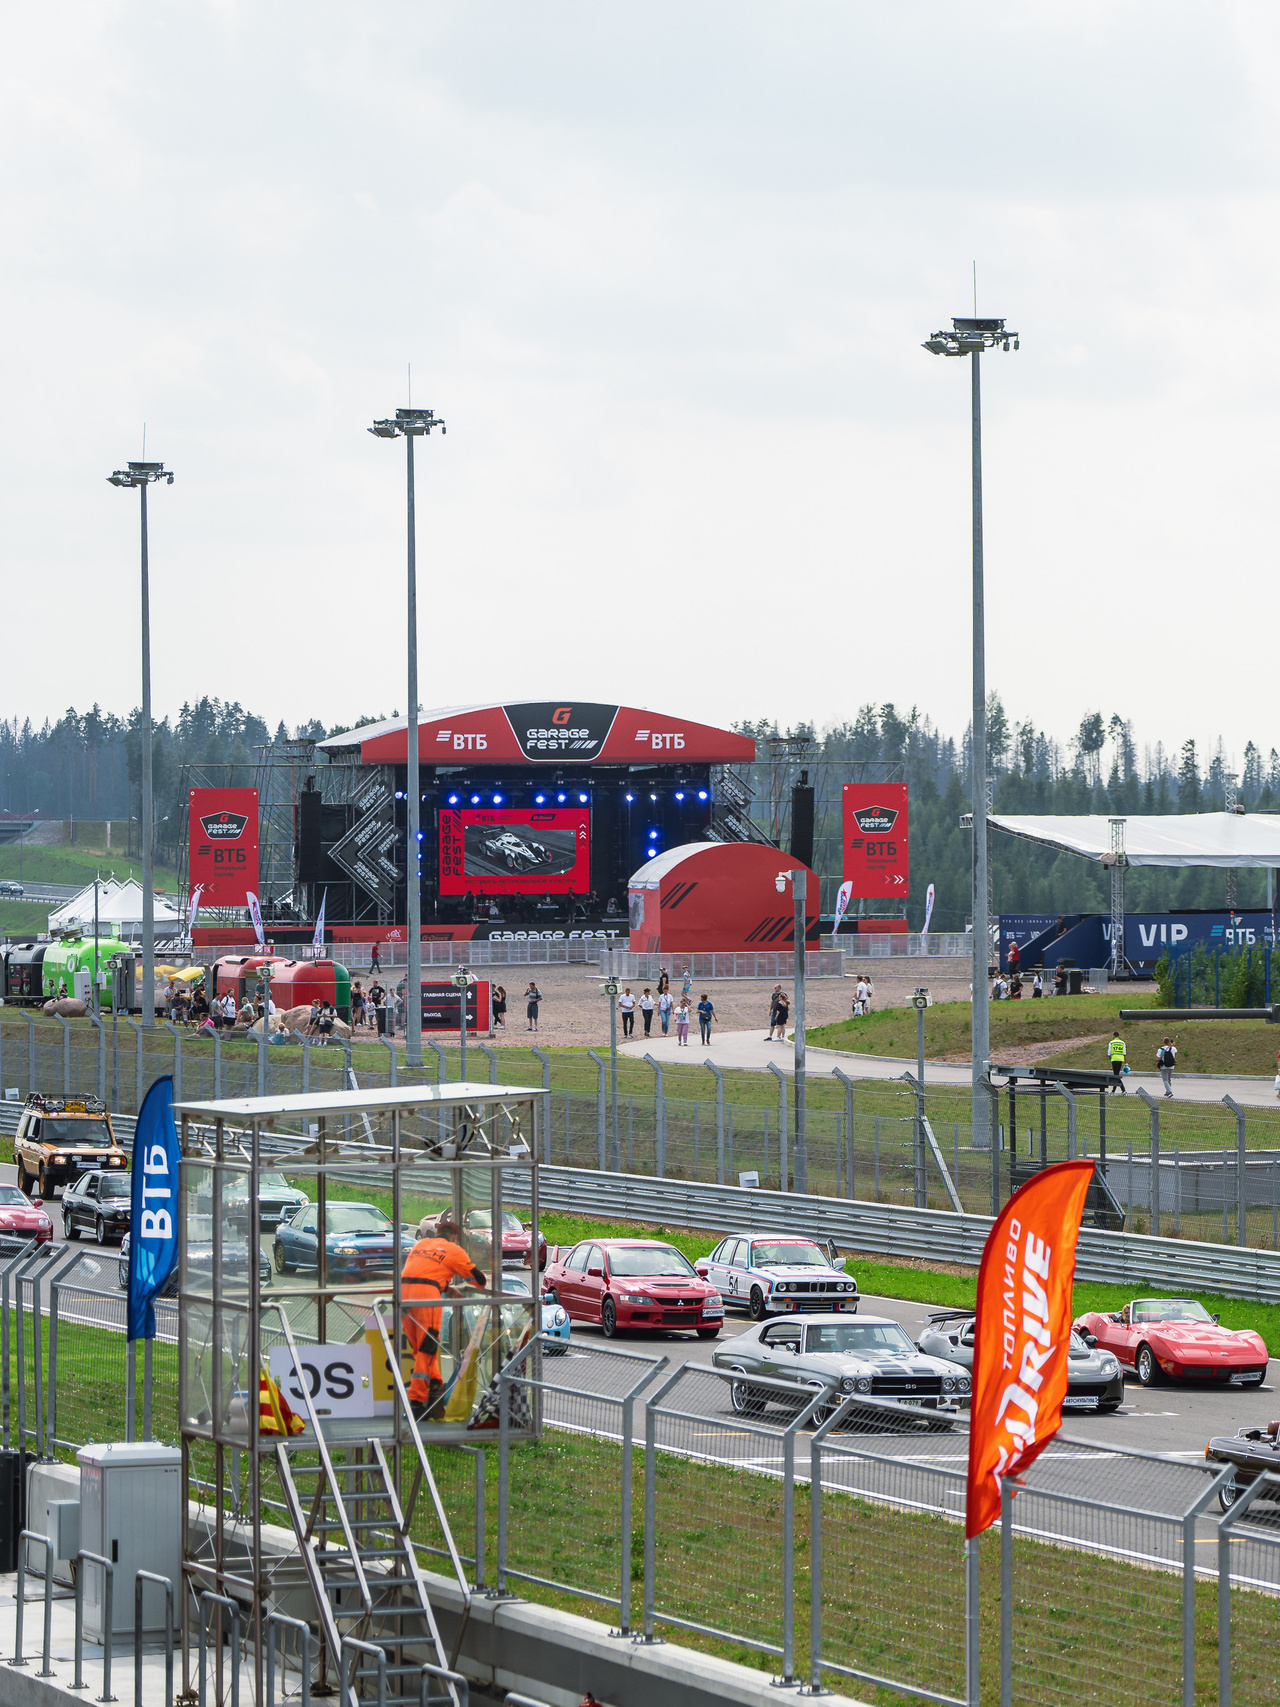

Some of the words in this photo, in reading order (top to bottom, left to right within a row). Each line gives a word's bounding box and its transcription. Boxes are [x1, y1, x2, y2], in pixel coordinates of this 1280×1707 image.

[453, 734, 488, 750] ВТБ
[652, 733, 686, 749] ВТБ
[214, 848, 247, 863] ВТБ
[867, 841, 897, 856] ВТБ
[1138, 923, 1188, 947] VIP
[140, 1144, 173, 1240] ВТБ
[728, 1276, 739, 1295] 54
[1002, 1218, 1022, 1371] ТОПЛИВО
